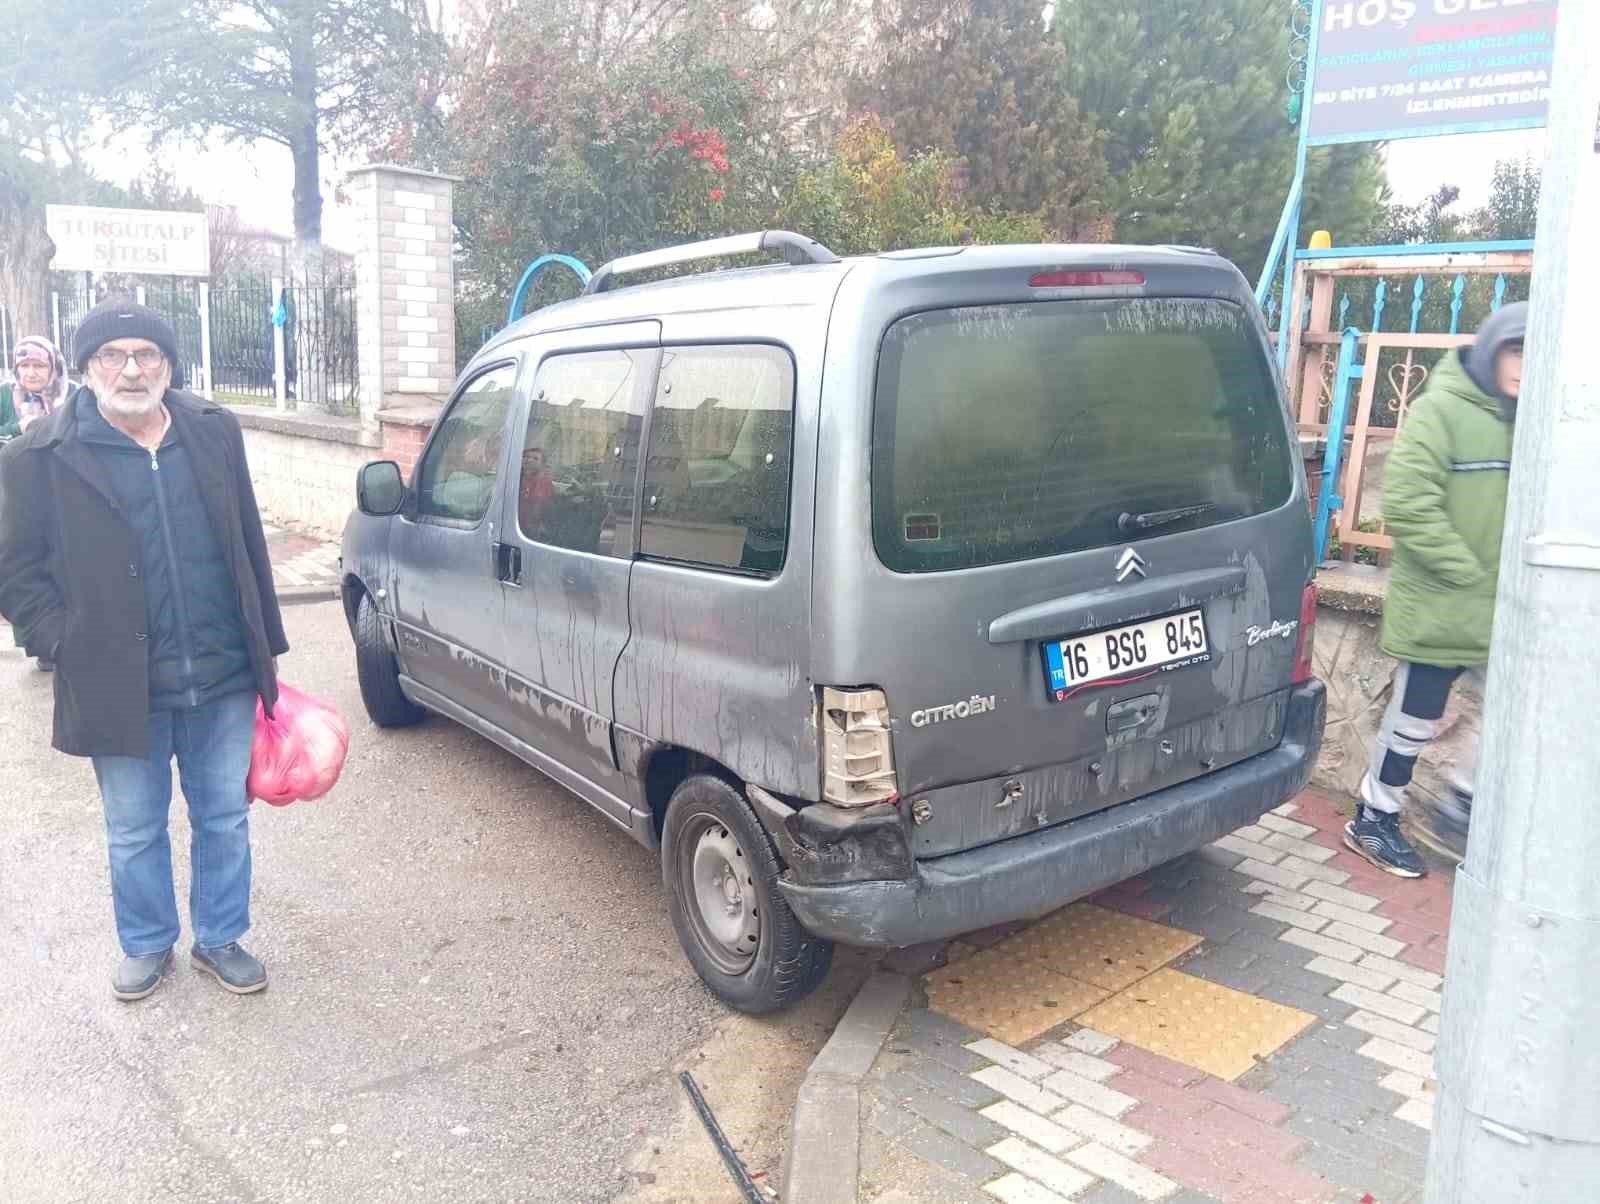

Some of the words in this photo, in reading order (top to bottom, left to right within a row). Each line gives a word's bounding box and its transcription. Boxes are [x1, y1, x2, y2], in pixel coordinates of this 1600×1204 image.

[1313, 91, 1336, 105] BU
[1419, 77, 1464, 94] SAAT
[1468, 69, 1548, 88] KAMERA
[1064, 643, 1089, 680] 16
[1105, 629, 1147, 670] BSG
[1165, 615, 1203, 655] 845
[911, 694, 996, 728] CITROËN
